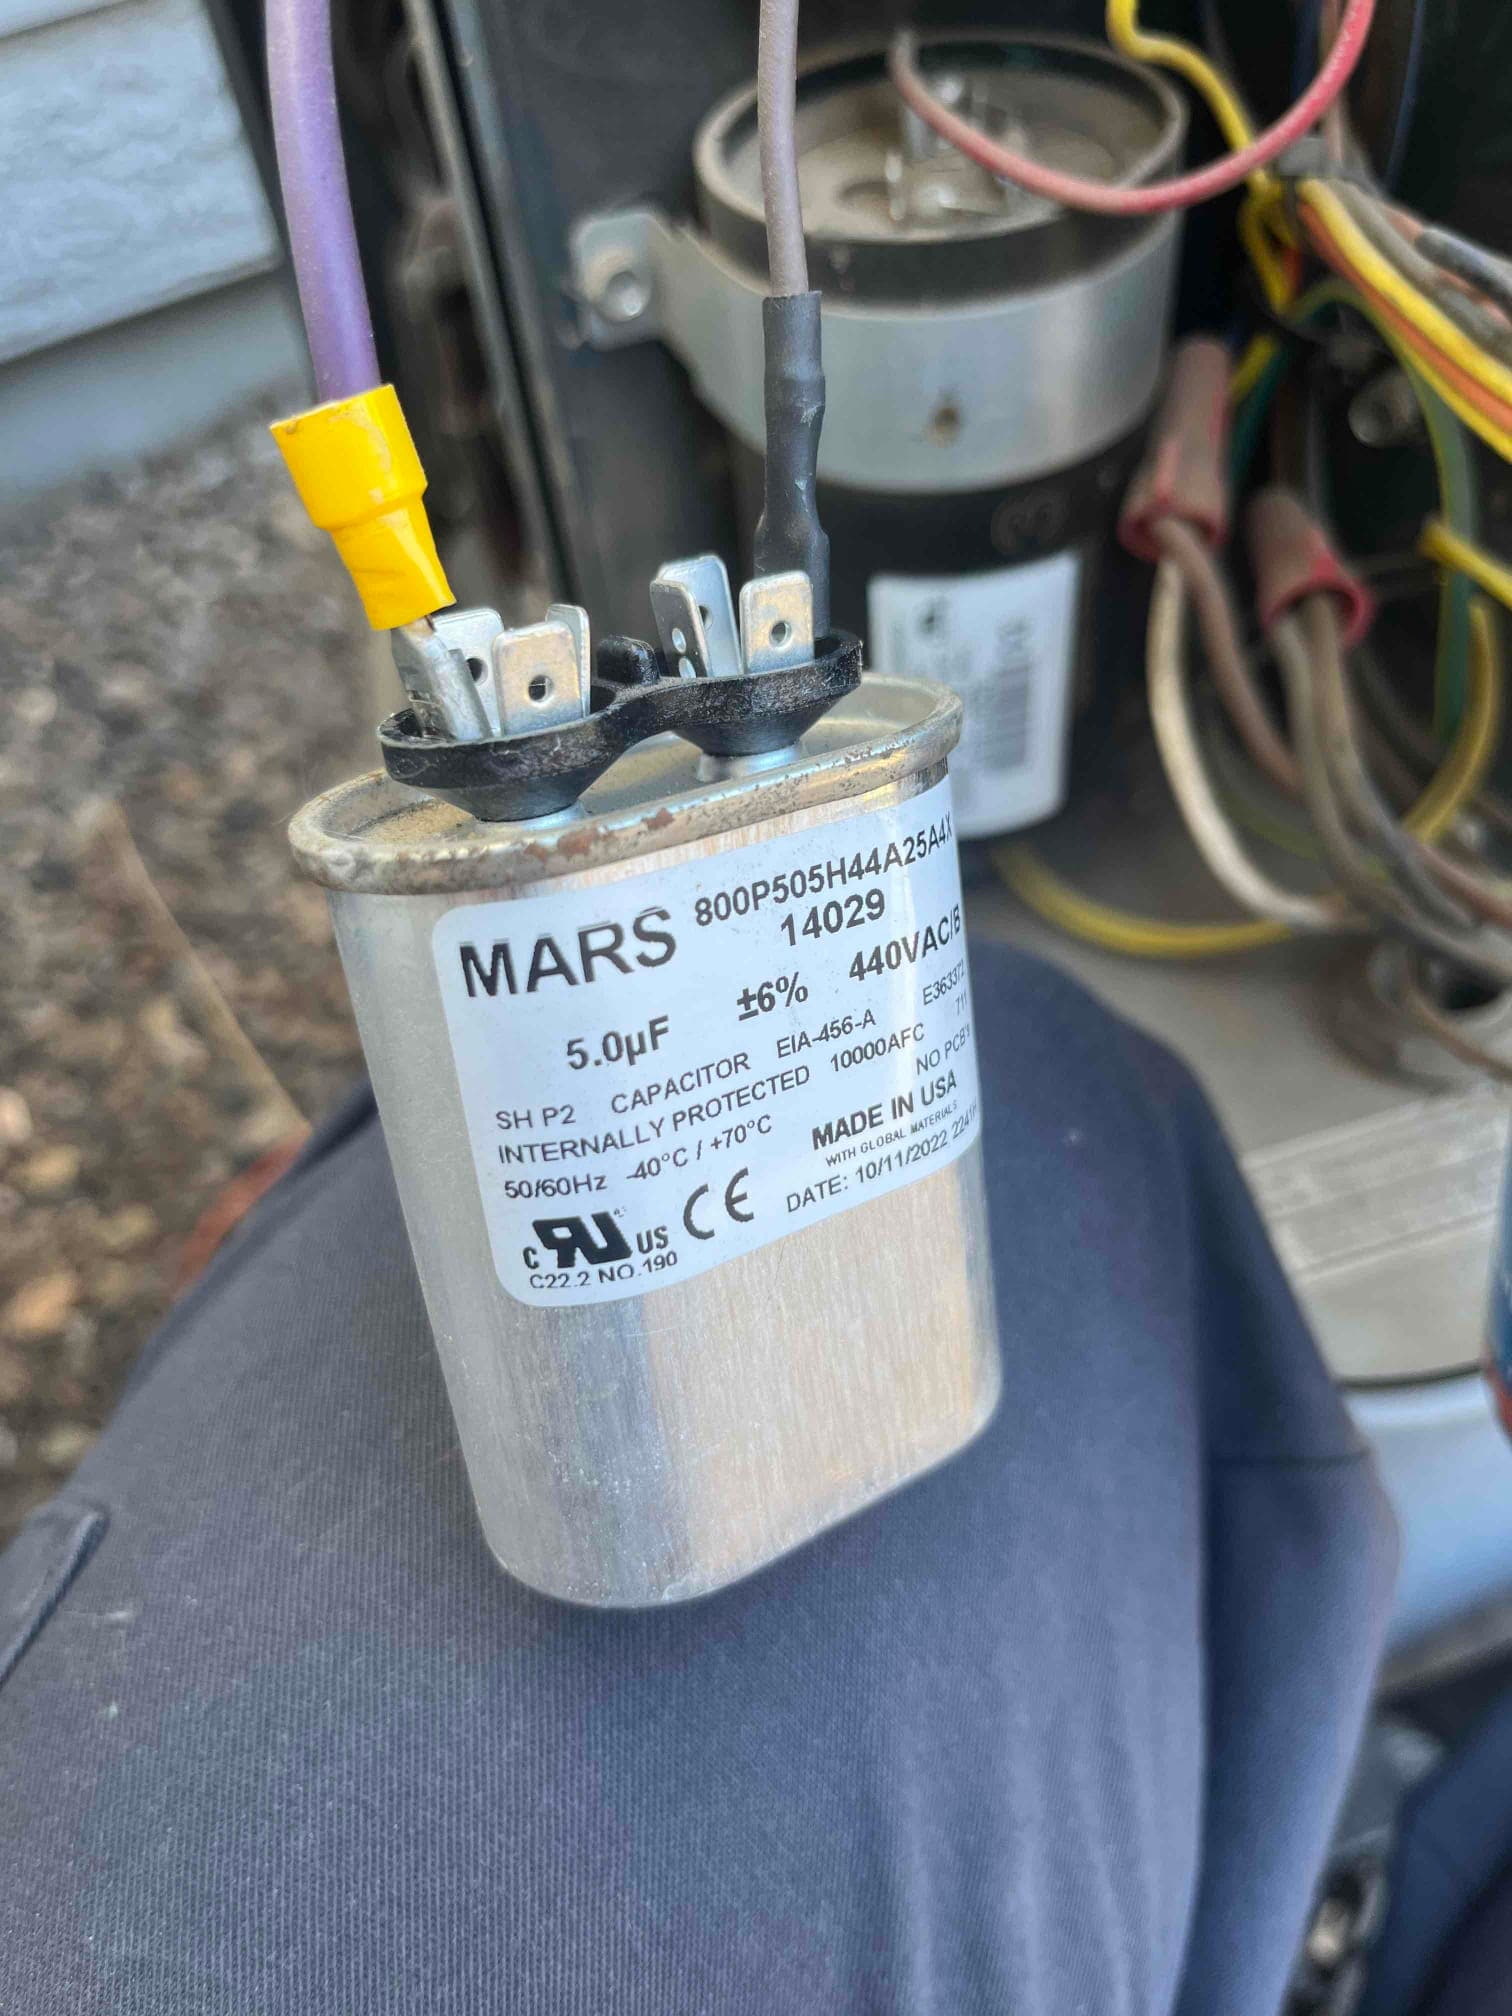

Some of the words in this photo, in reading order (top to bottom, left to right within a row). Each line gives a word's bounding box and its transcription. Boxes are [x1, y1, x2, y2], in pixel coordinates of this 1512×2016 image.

[781, 888, 885, 946] 14029
[459, 907, 677, 998] MARS
[737, 971, 809, 1021] ±6%
[566, 1015, 669, 1070] 5.0µF
[776, 1008, 877, 1059] EIA-456-A
[830, 1023, 925, 1073] 10000AFC
[611, 1052, 751, 1114] CAPACITOR
[916, 1049, 941, 1076] NO
[496, 1110, 533, 1130] SH
[543, 1104, 576, 1127] P2
[499, 1117, 665, 1164] INTERNALLY
[672, 1065, 811, 1132] PROTECTED
[812, 1103, 884, 1150] MADE
[891, 1091, 914, 1121] IN
[920, 1069, 957, 1107] USA
[826, 1148, 857, 1168] WITH
[860, 1128, 907, 1155] GLOBAL
[910, 1099, 958, 1135] MATERIALS
[504, 1173, 608, 1199] 50/60Hz
[787, 1175, 849, 1213] DATE:
[855, 1130, 948, 1184] 10/11/2022
[529, 1270, 592, 1289] C22.2
